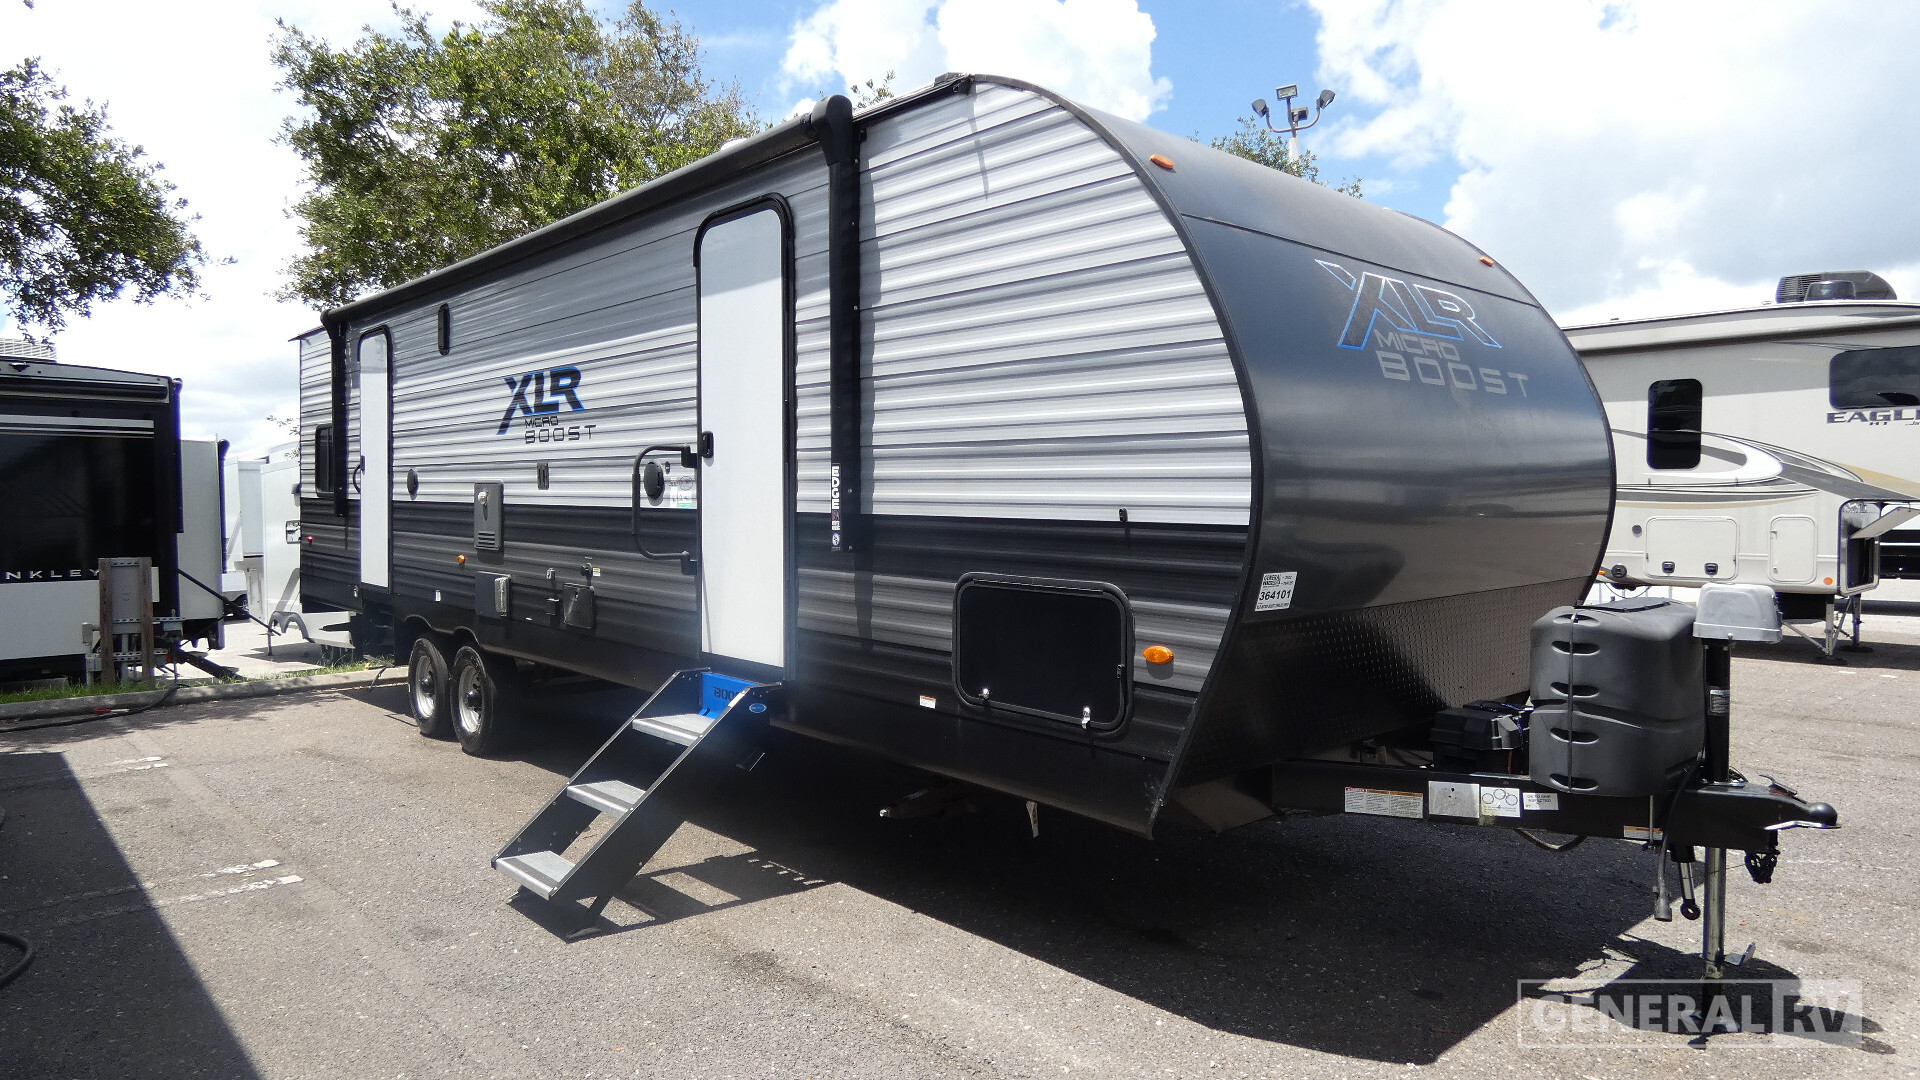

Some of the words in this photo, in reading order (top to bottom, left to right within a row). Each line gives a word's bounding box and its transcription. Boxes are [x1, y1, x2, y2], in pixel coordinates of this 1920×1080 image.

[1314, 258, 1503, 351] XLR
[1374, 329, 1461, 362] MICRO
[1376, 350, 1530, 398] BOOST
[495, 365, 586, 436] XLR
[524, 415, 559, 428] MICRO
[1826, 410, 1920, 423] EAGL
[524, 425, 597, 445] BOOST
[831, 465, 840, 510] EDGE
[1259, 590, 1291, 600] 364101
[713, 686, 740, 701] BOO
